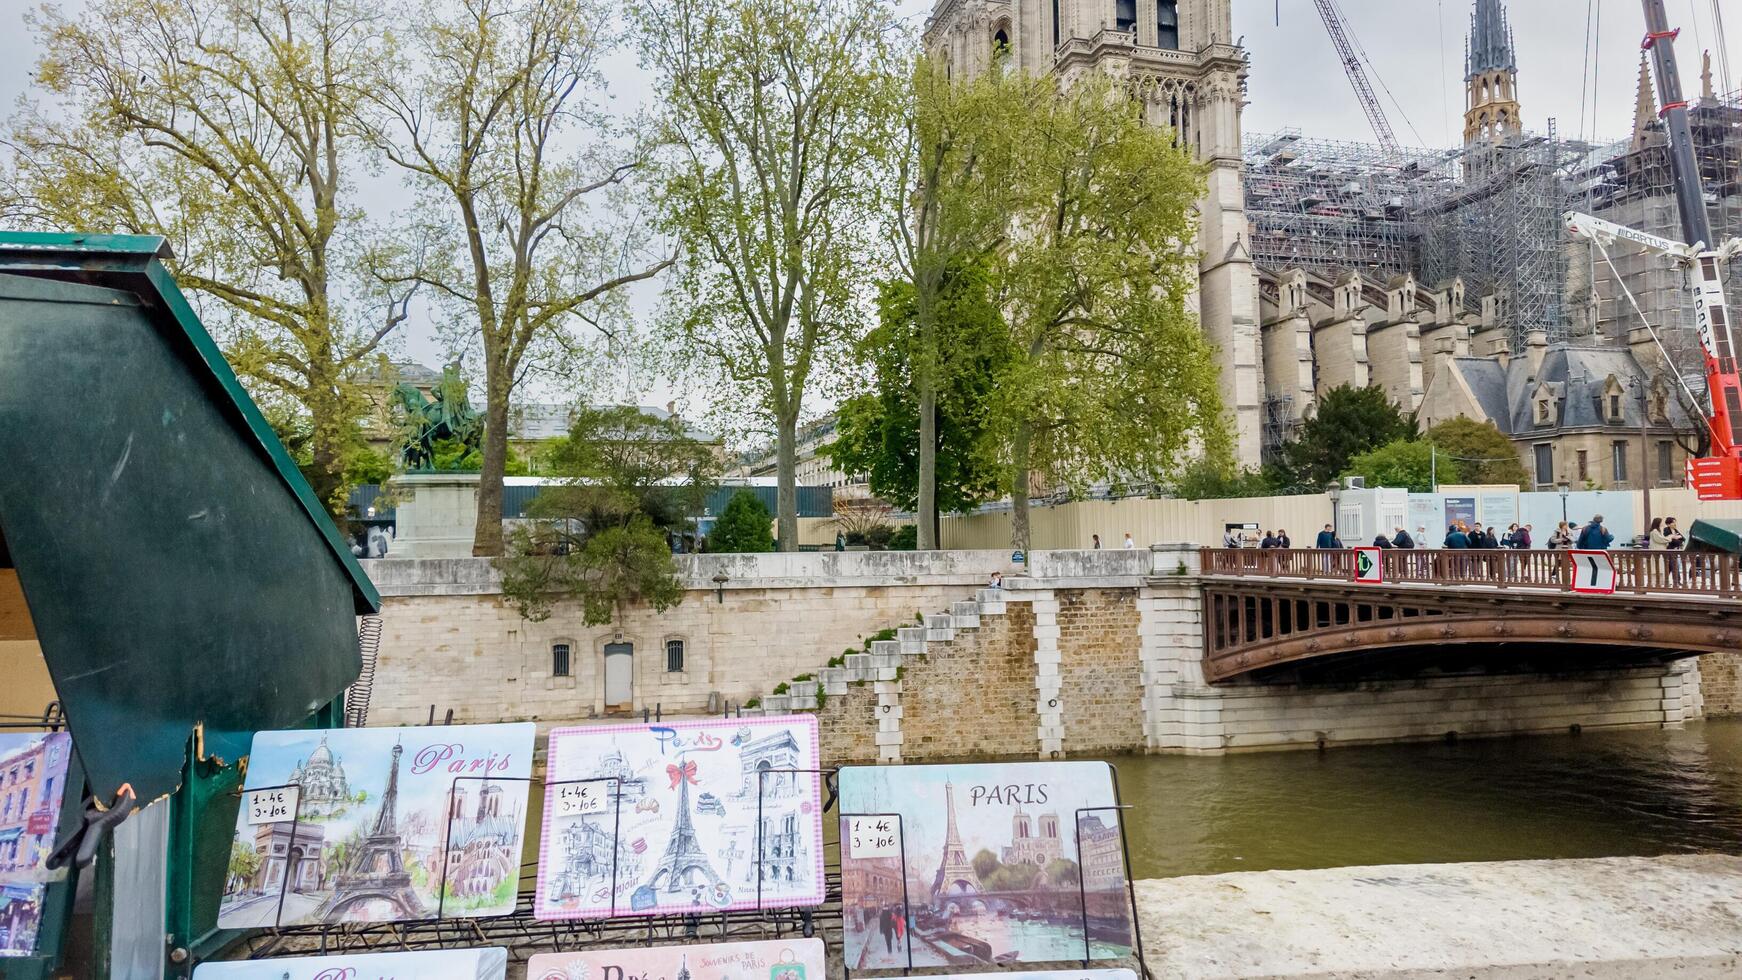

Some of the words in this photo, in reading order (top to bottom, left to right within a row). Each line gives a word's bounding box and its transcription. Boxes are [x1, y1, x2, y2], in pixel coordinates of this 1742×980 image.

[1625, 229, 1670, 250] DARTUS
[649, 726, 723, 757] Paris
[411, 743, 511, 775] Paris
[970, 783, 1048, 807] PARIS
[741, 959, 766, 971] PARIS
